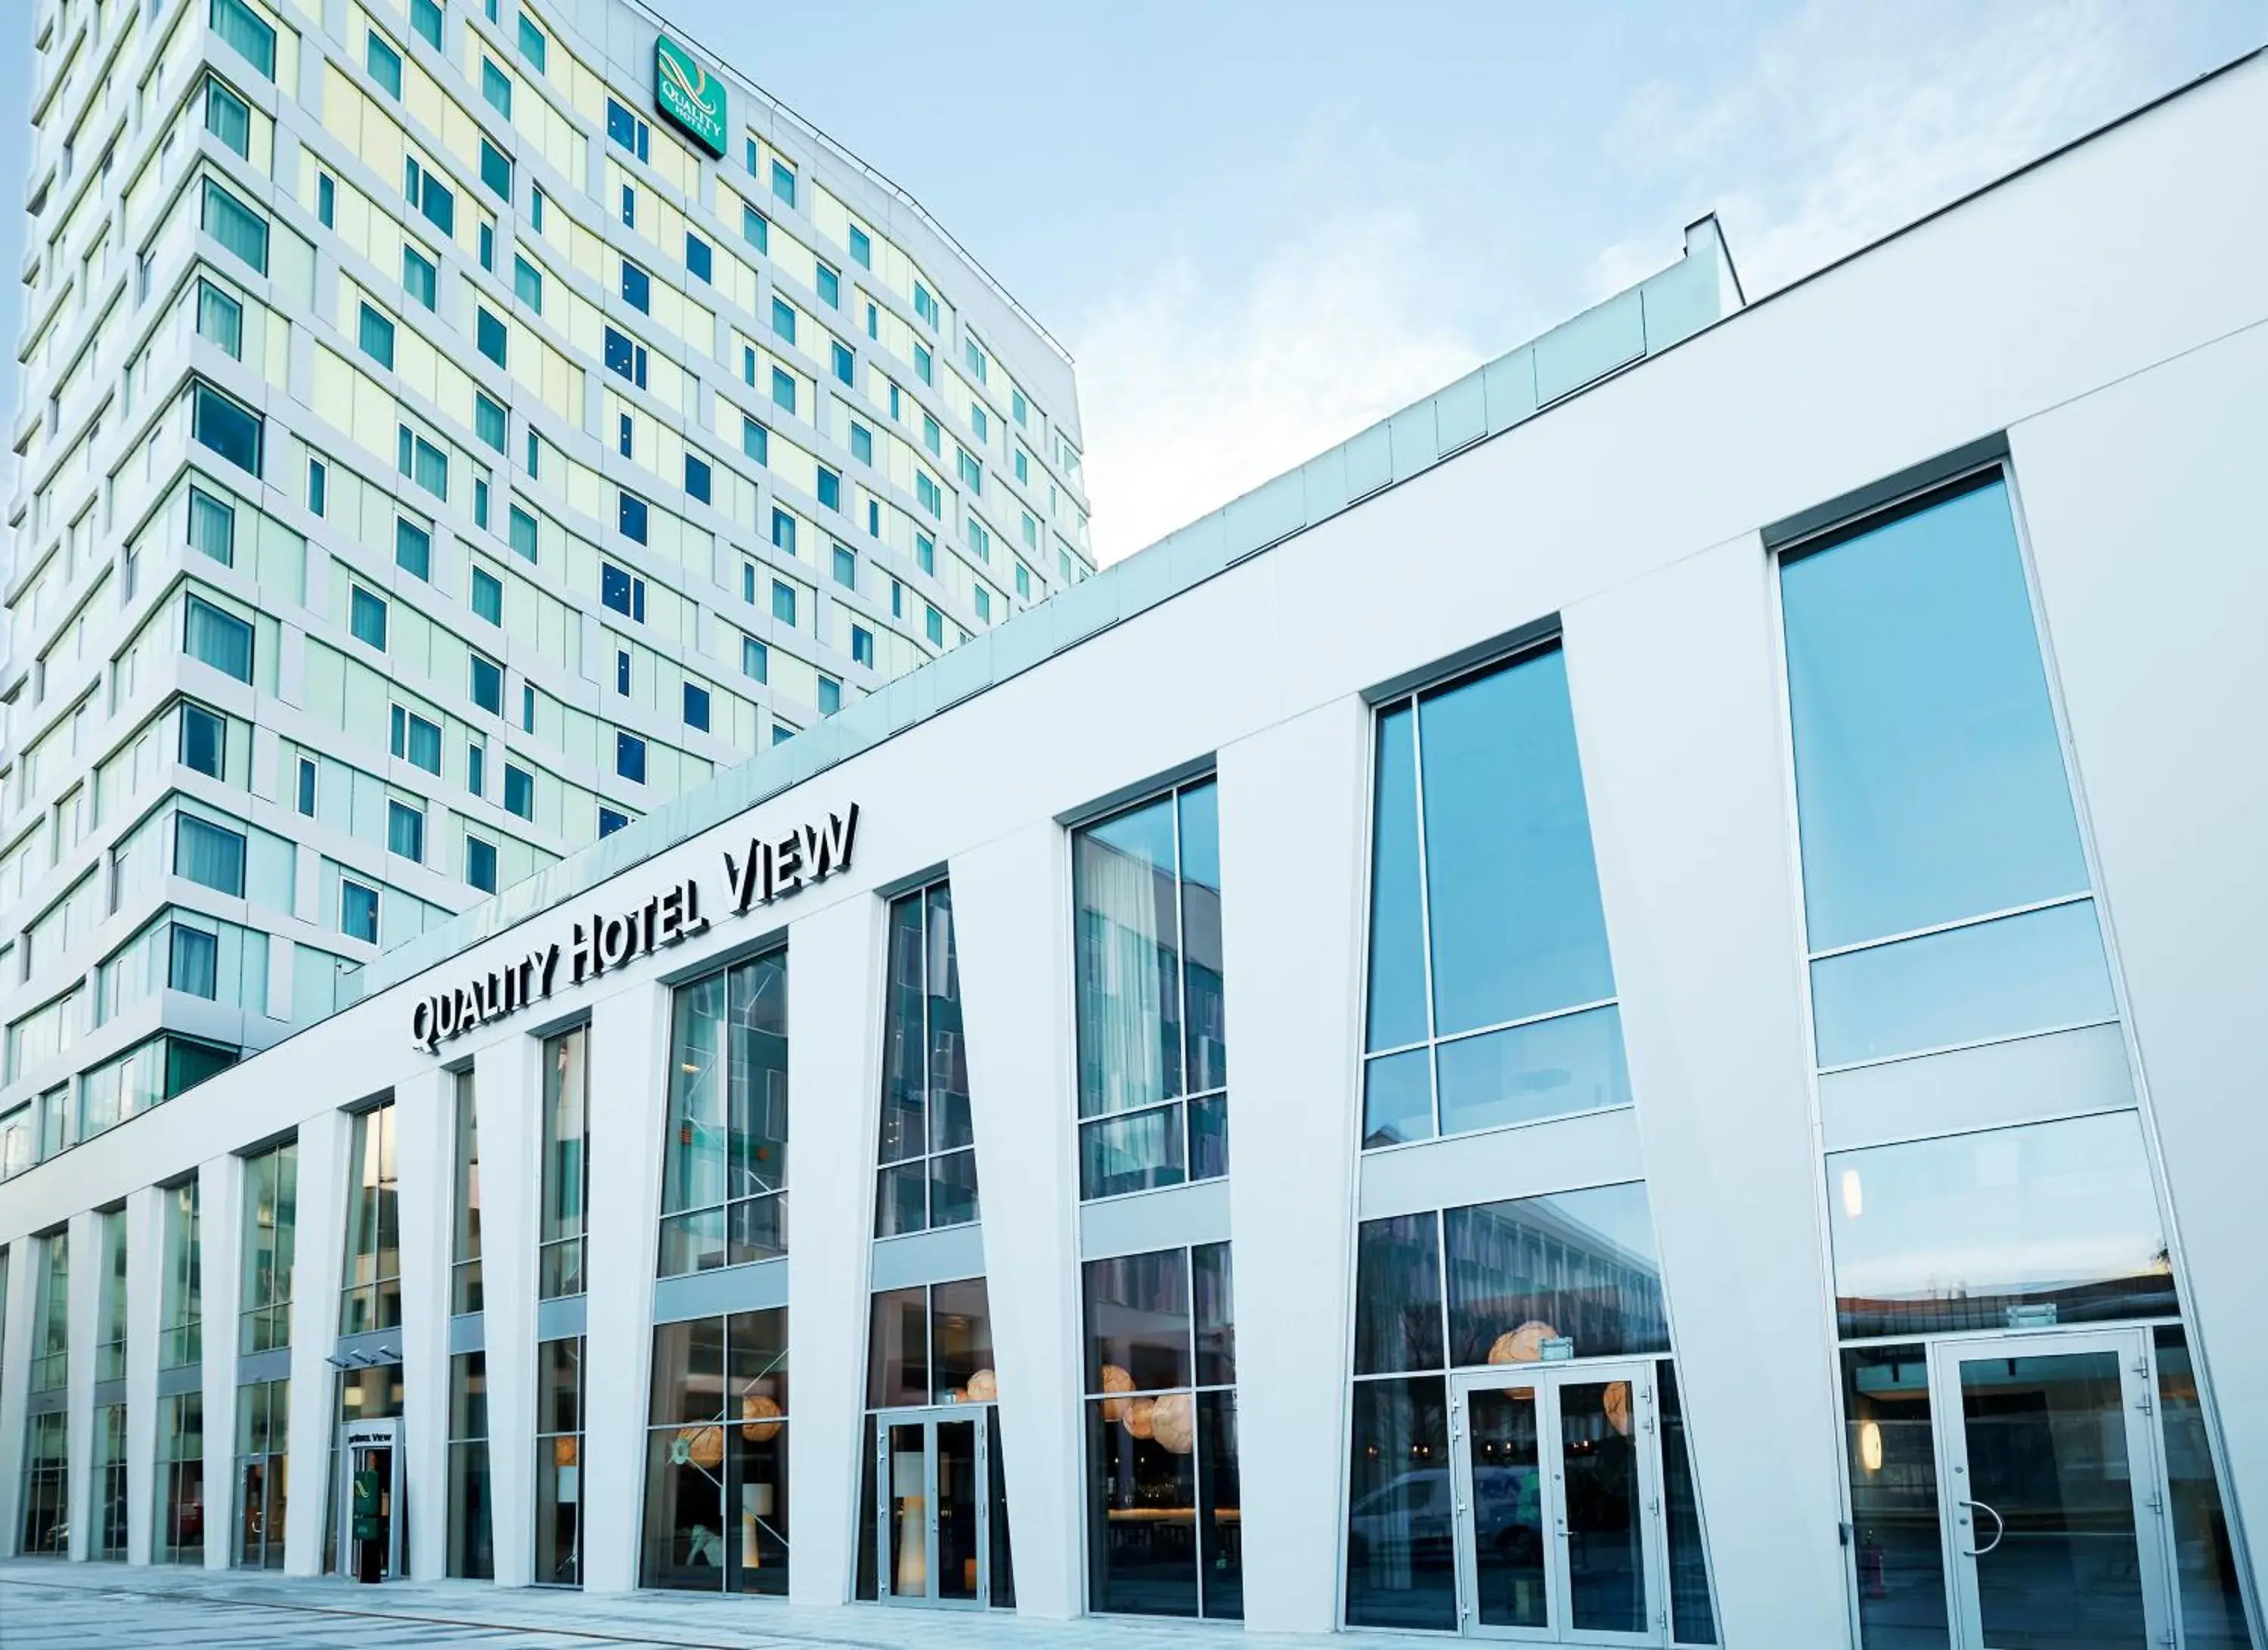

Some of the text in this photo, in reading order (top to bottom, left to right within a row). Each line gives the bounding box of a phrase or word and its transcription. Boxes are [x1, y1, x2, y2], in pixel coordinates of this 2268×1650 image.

[662, 81, 721, 136] QUALITY
[675, 104, 708, 136] HOTEL
[413, 802, 859, 1055] QUALITY HOTEL VIEW
